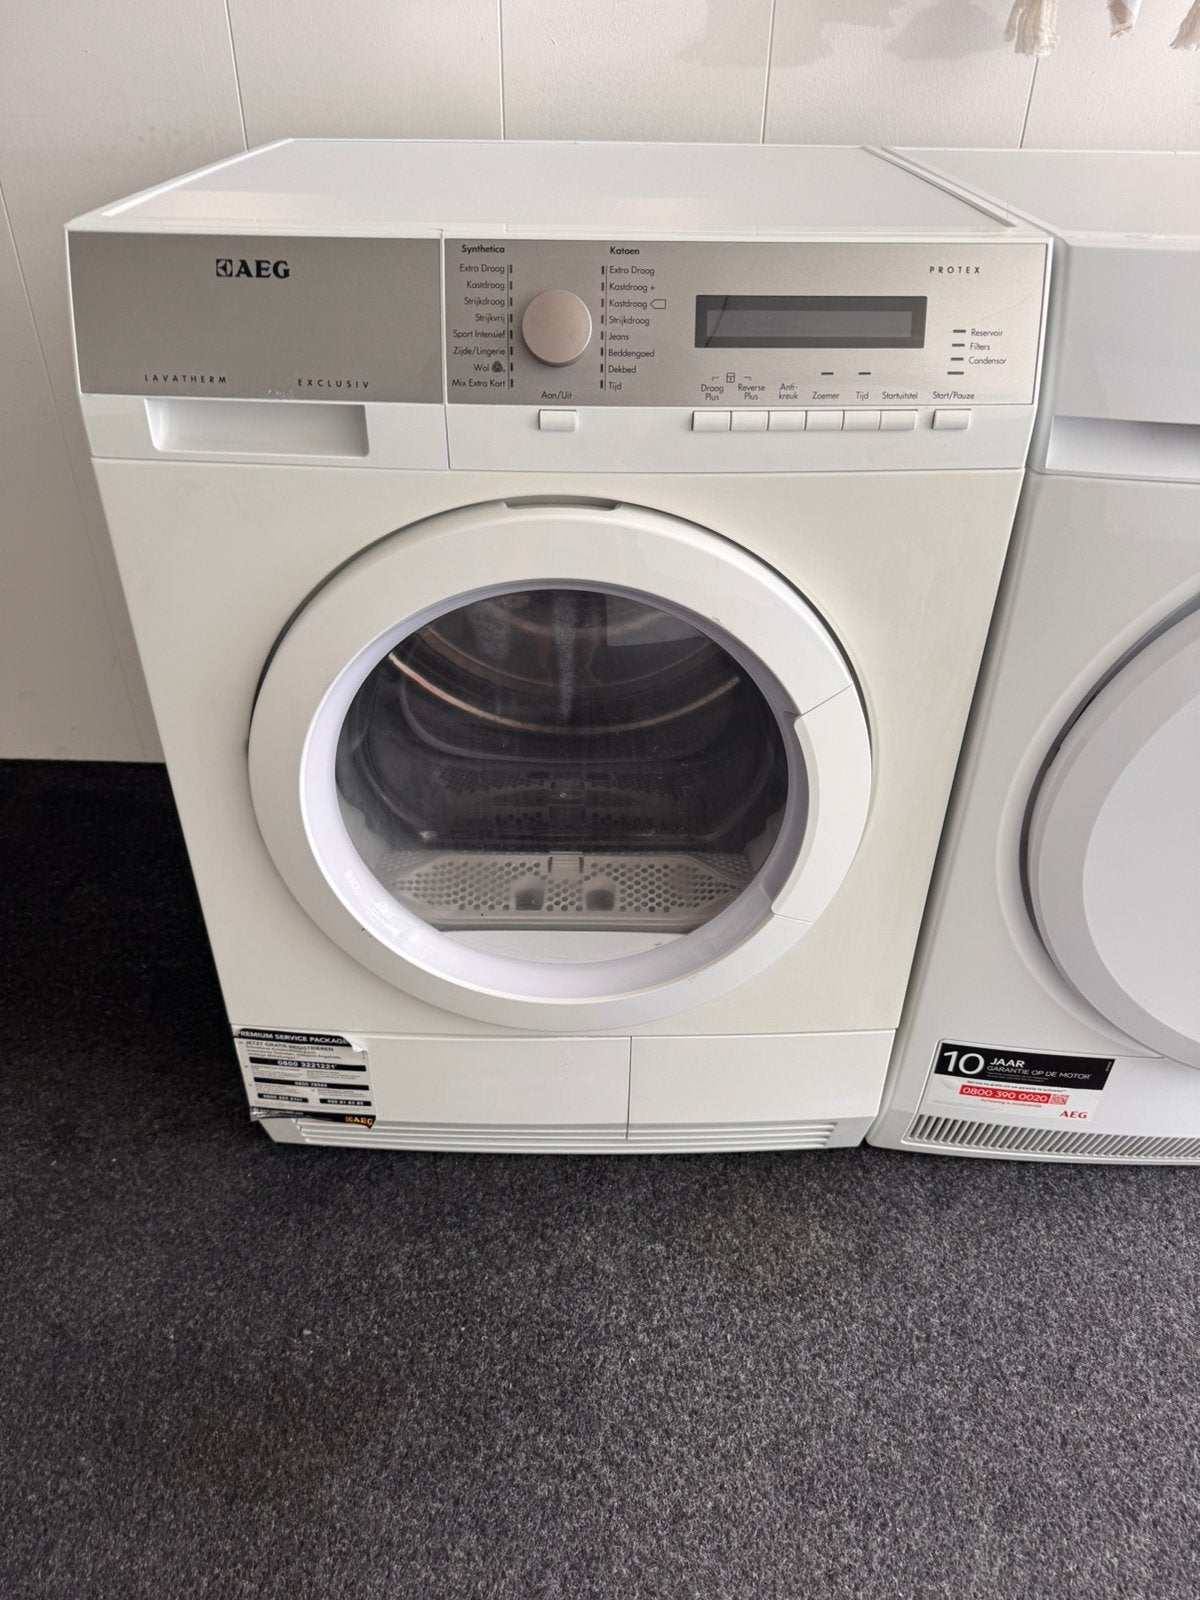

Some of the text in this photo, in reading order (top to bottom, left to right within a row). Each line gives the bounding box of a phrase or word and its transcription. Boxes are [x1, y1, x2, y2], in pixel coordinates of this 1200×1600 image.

[609, 246, 640, 255] Katoen
[235, 259, 291, 279] AEG
[459, 264, 505, 275] Extra Droog
[609, 265, 655, 276] Extra Droog
[929, 266, 981, 274] PROTEX
[466, 281, 505, 291] Kastdroog
[609, 282, 648, 293] Kastdroog
[464, 297, 505, 308] Strijkdroog
[609, 299, 648, 310] Kastdroog
[475, 313, 506, 324] Strijkvrij
[609, 315, 650, 326] Strijkdroog
[453, 330, 506, 340] Sport Intensief
[608, 333, 629, 341] Jeans
[971, 328, 1004, 337] Reservoir
[453, 346, 506, 357] Zijde/Lingerie
[969, 342, 990, 351] Filters
[608, 349, 655, 359] Beddengoed
[968, 356, 1007, 365] Condensor
[474, 364, 490, 372] Wol
[608, 365, 637, 373] Dekbed
[144, 373, 227, 384] LAVATHERM
[298, 378, 370, 389] EXCLUSIV
[452, 379, 506, 388] Mix Extra Kort
[609, 382, 622, 392] Tijd
[701, 384, 725, 394] Droog
[738, 383, 766, 391] Reverse
[780, 383, 798, 391] Anti-
[541, 391, 573, 401] Aan/Uit
[705, 392, 720, 401] Plus
[744, 392, 759, 401] Plus
[779, 391, 798, 400] kreuk
[812, 391, 840, 400] Zoemer
[856, 391, 870, 401] Tijd
[881, 391, 919, 400] Startuitstel
[932, 391, 975, 401] Start/Pauze
[274, 1033, 308, 1042] SERVICE
[943, 1050, 985, 1075] 10
[989, 1057, 1026, 1069] JAAR
[987, 1065, 1030, 1075] GARANTIE
[962, 1087, 1048, 1102] 0800 390 0020
[1059, 1110, 1087, 1119] AEG
